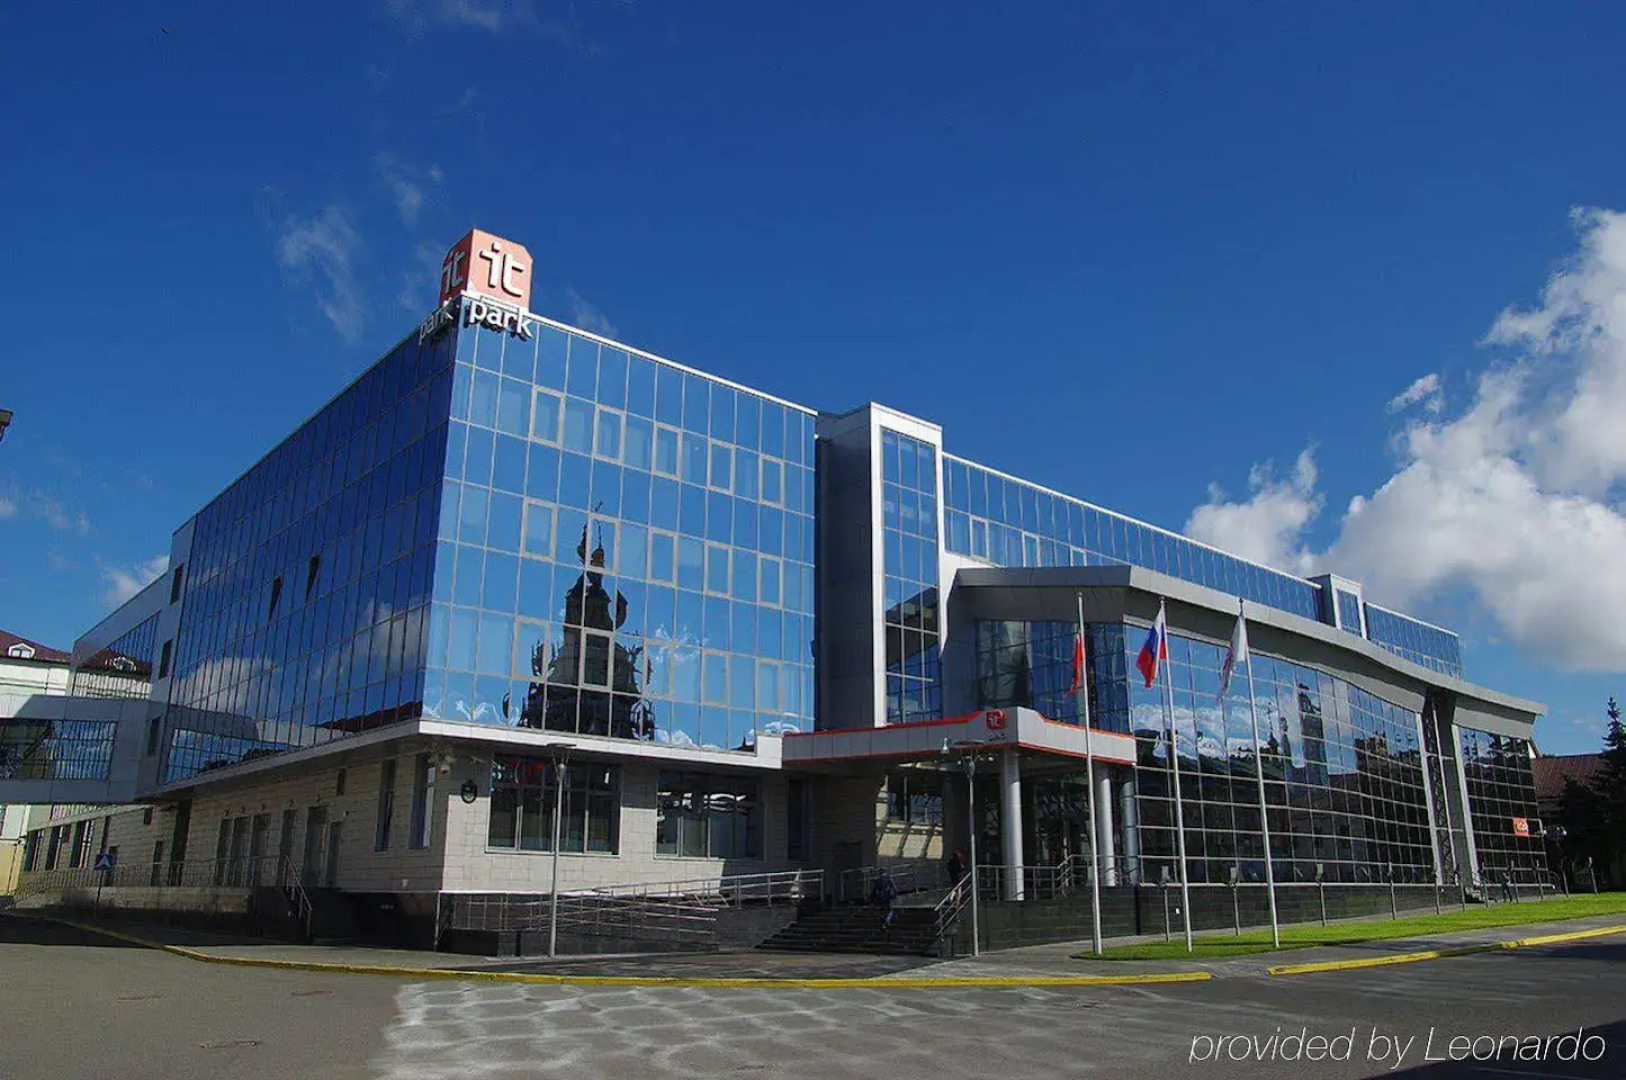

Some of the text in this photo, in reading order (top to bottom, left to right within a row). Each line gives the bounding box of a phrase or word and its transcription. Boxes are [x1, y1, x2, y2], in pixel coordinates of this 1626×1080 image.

[479, 241, 525, 297] it
[418, 301, 454, 346] park
[467, 300, 533, 339] park
